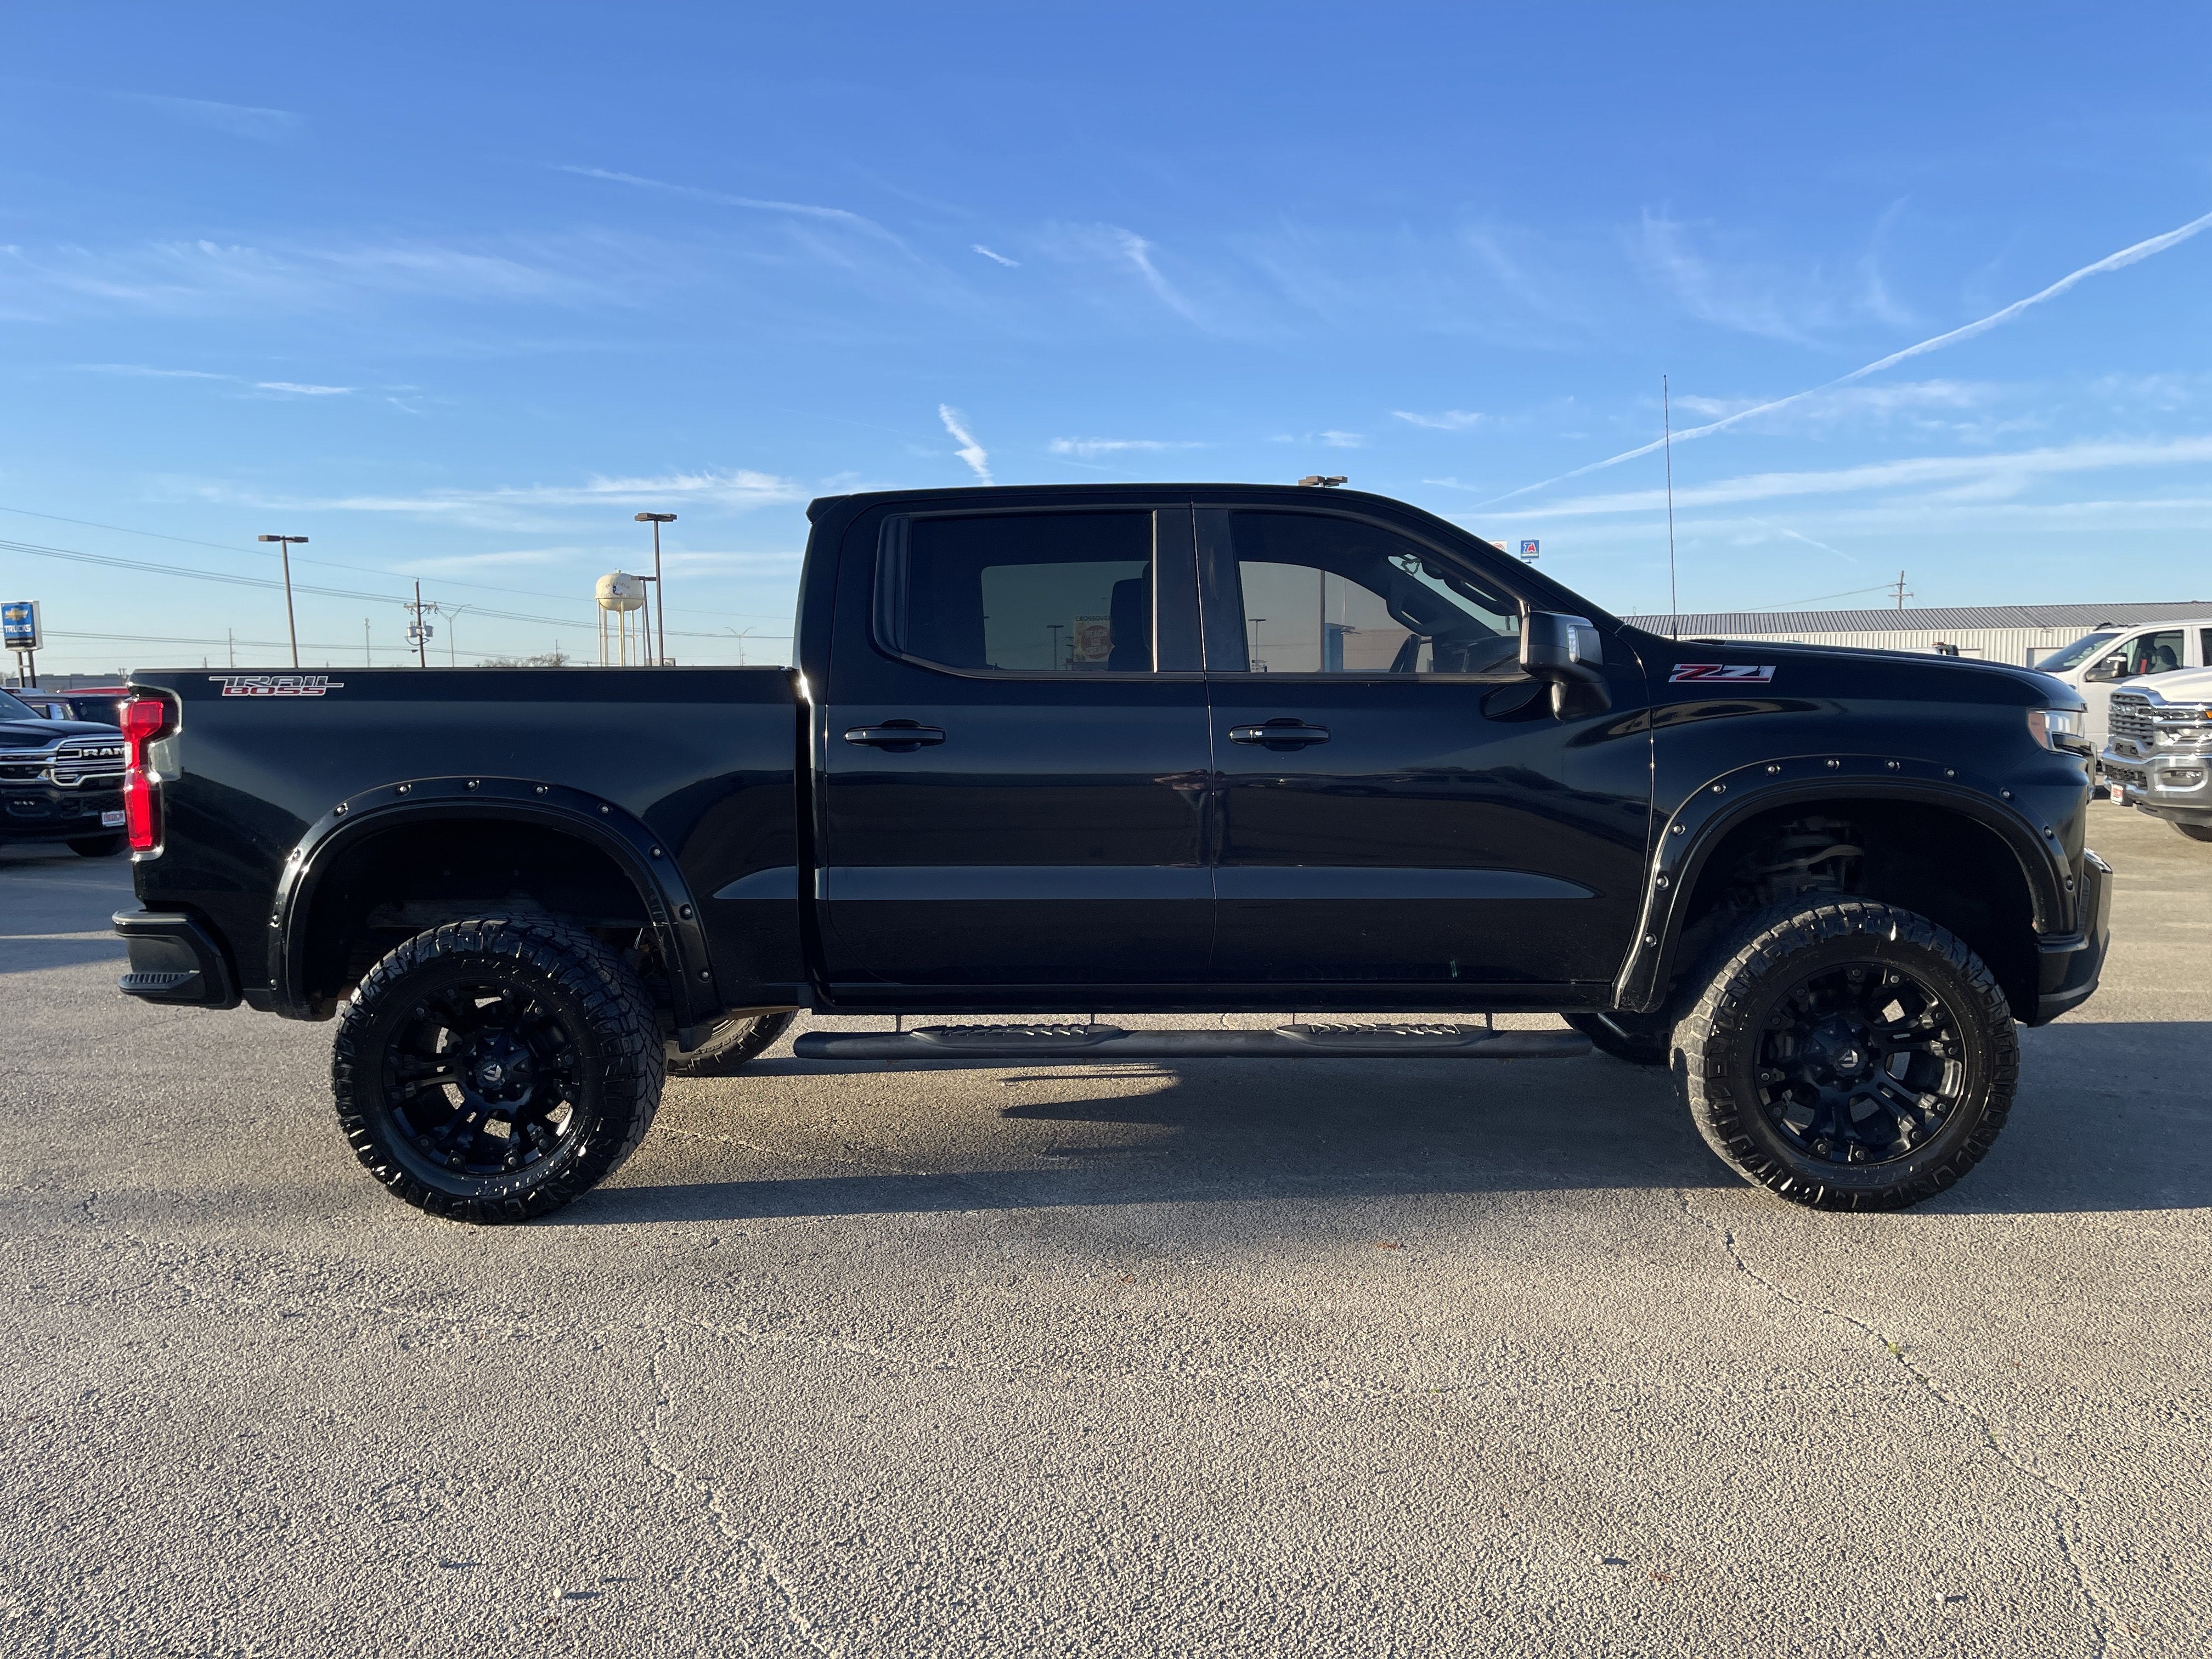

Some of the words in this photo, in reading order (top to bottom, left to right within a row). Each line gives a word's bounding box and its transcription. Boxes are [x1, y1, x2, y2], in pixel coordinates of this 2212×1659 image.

[1523, 542, 1537, 553] TA
[4, 624, 32, 633] TRUCKS
[1668, 664, 1776, 683] Z71
[208, 676, 345, 688] TRAIL
[222, 686, 328, 696] BOSS
